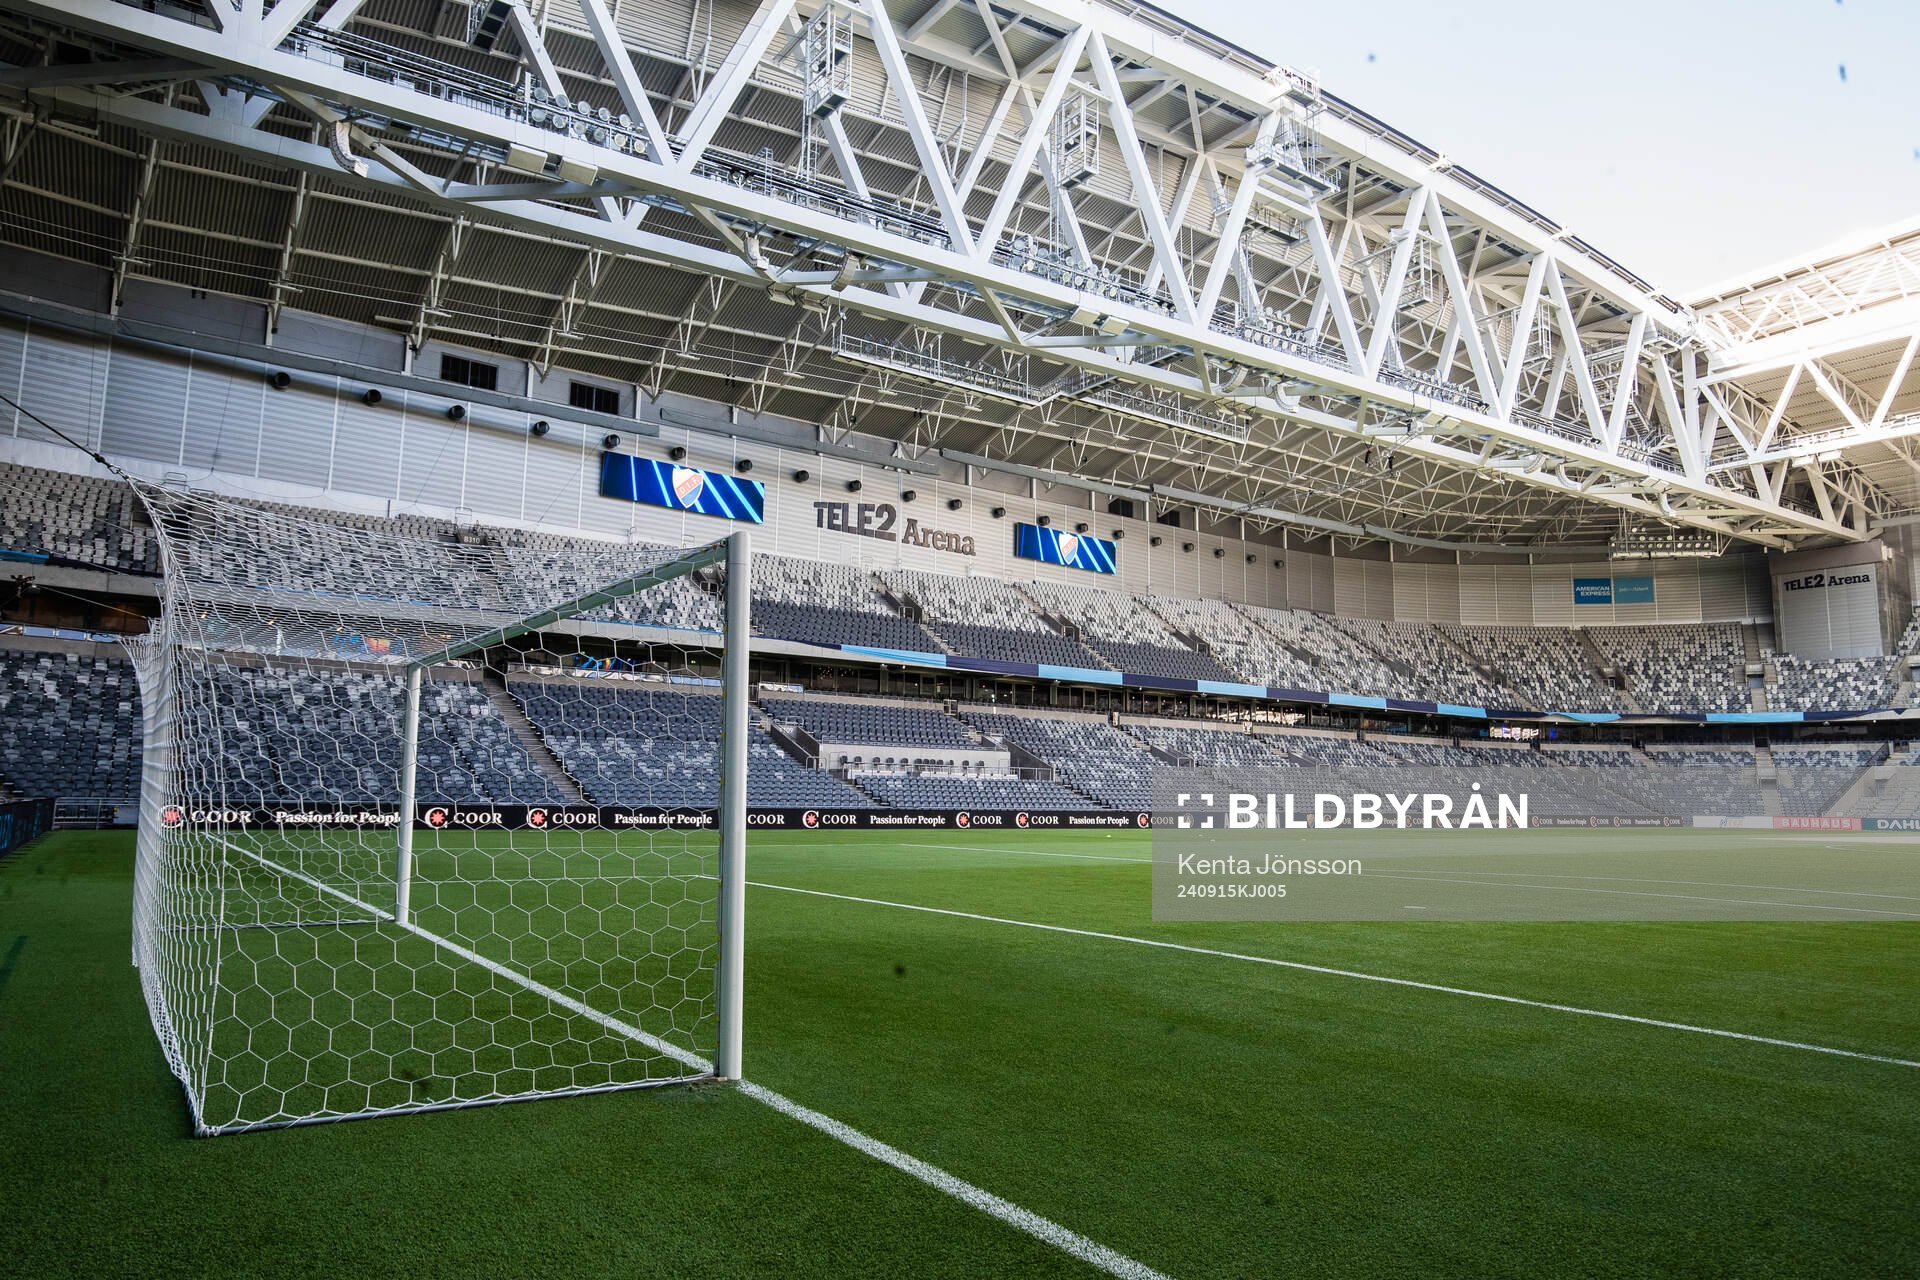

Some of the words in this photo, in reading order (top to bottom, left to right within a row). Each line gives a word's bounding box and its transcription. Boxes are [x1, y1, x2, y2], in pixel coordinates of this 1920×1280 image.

[813, 501, 897, 542] TELE2
[901, 517, 977, 557] Arena
[1783, 573, 1825, 591] TELE2
[1827, 573, 1871, 587] Arena
[191, 810, 252, 823] COOR
[276, 811, 333, 823] Passion
[333, 811, 358, 823] for
[359, 811, 401, 827] Peopl
[453, 812, 503, 824] COOR
[552, 812, 598, 824] COOR
[614, 813, 657, 824] Passion
[658, 813, 676, 824] for
[677, 814, 713, 827] People
[747, 814, 785, 824] COOR
[822, 814, 857, 824] COOR
[870, 815, 903, 824] Passion
[903, 815, 918, 824] for
[918, 815, 946, 827] People
[972, 815, 1002, 825] COOR
[1031, 816, 1059, 825] COOR
[1069, 816, 1096, 825] Passion
[1096, 816, 1106, 825] for
[1106, 816, 1130, 827] People
[1150, 816, 1175, 825] COOR
[1782, 818, 1851, 829] BAUHAUS
